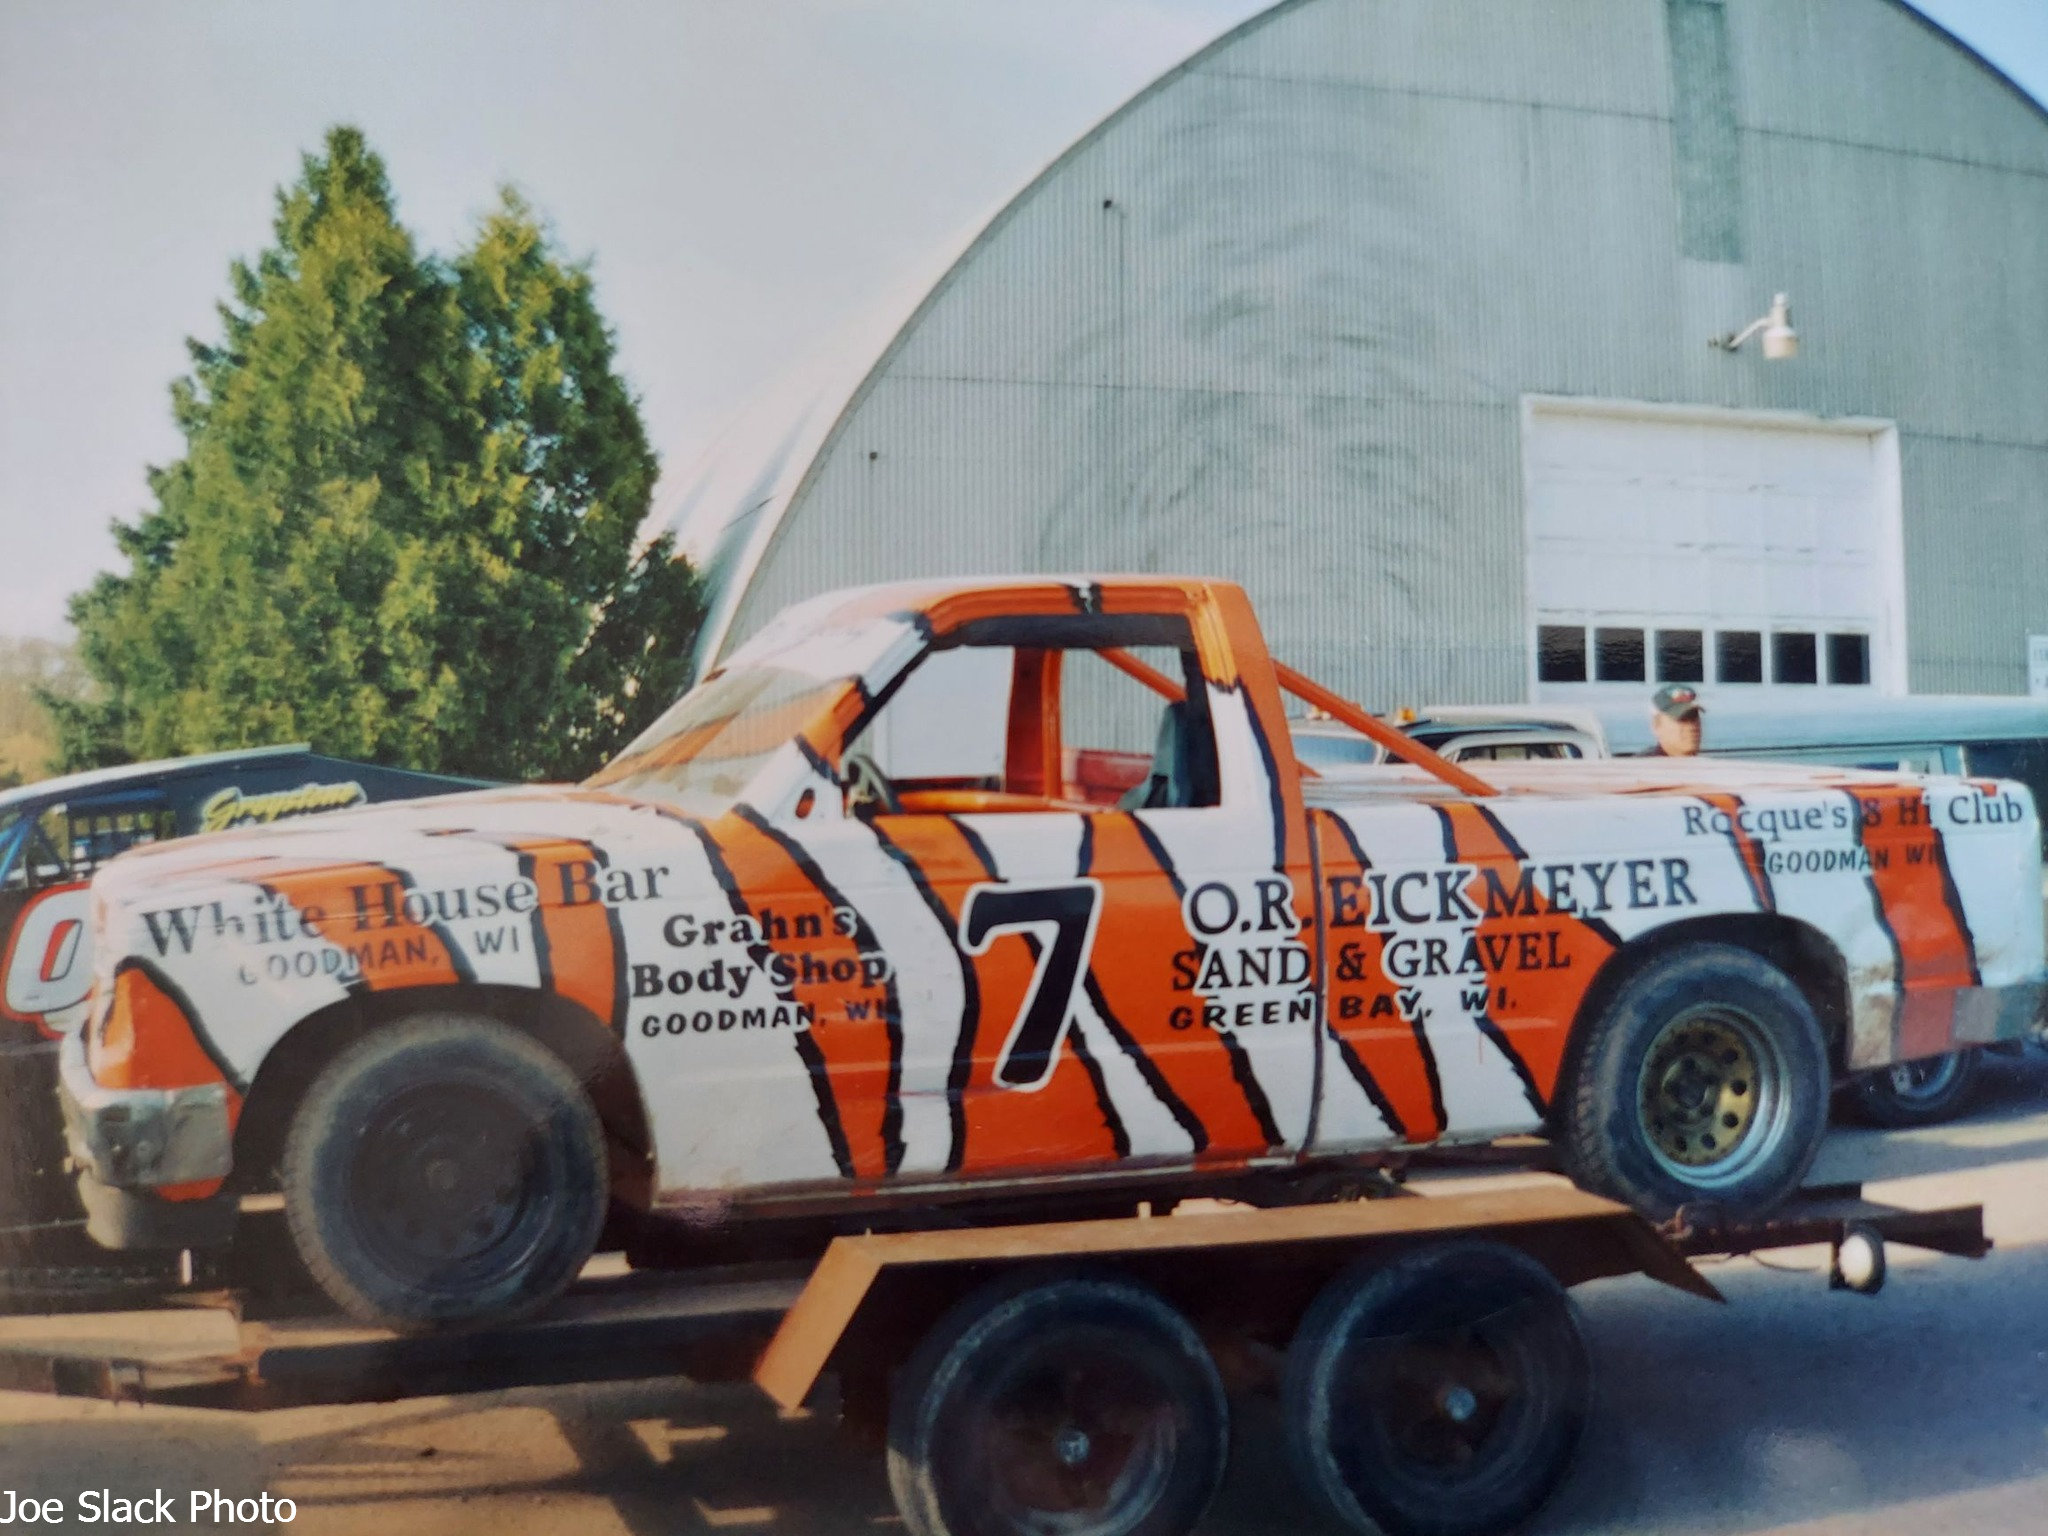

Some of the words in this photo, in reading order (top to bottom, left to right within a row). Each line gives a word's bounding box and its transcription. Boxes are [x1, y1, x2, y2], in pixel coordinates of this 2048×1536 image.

[1683, 800, 1849, 841] Rocque's
[1898, 795, 1932, 826] Hi
[1948, 792, 2023, 825] Club
[1768, 848, 1889, 875] GOODMAN
[140, 893, 326, 957] White
[351, 881, 535, 932] House
[556, 860, 670, 908] Bar
[1328, 857, 1698, 928] EICKMEYER
[474, 927, 518, 956] WI
[662, 907, 856, 947] Grahn's
[630, 962, 755, 1001] Body
[771, 952, 889, 989] Shop
[958, 878, 1103, 1091] 7
[1172, 945, 1312, 993] SAND
[1336, 942, 1368, 981] &
[1388, 930, 1572, 978] GRAVEL
[1169, 997, 1312, 1031] GREEN
[1339, 990, 1432, 1020] BAY,
